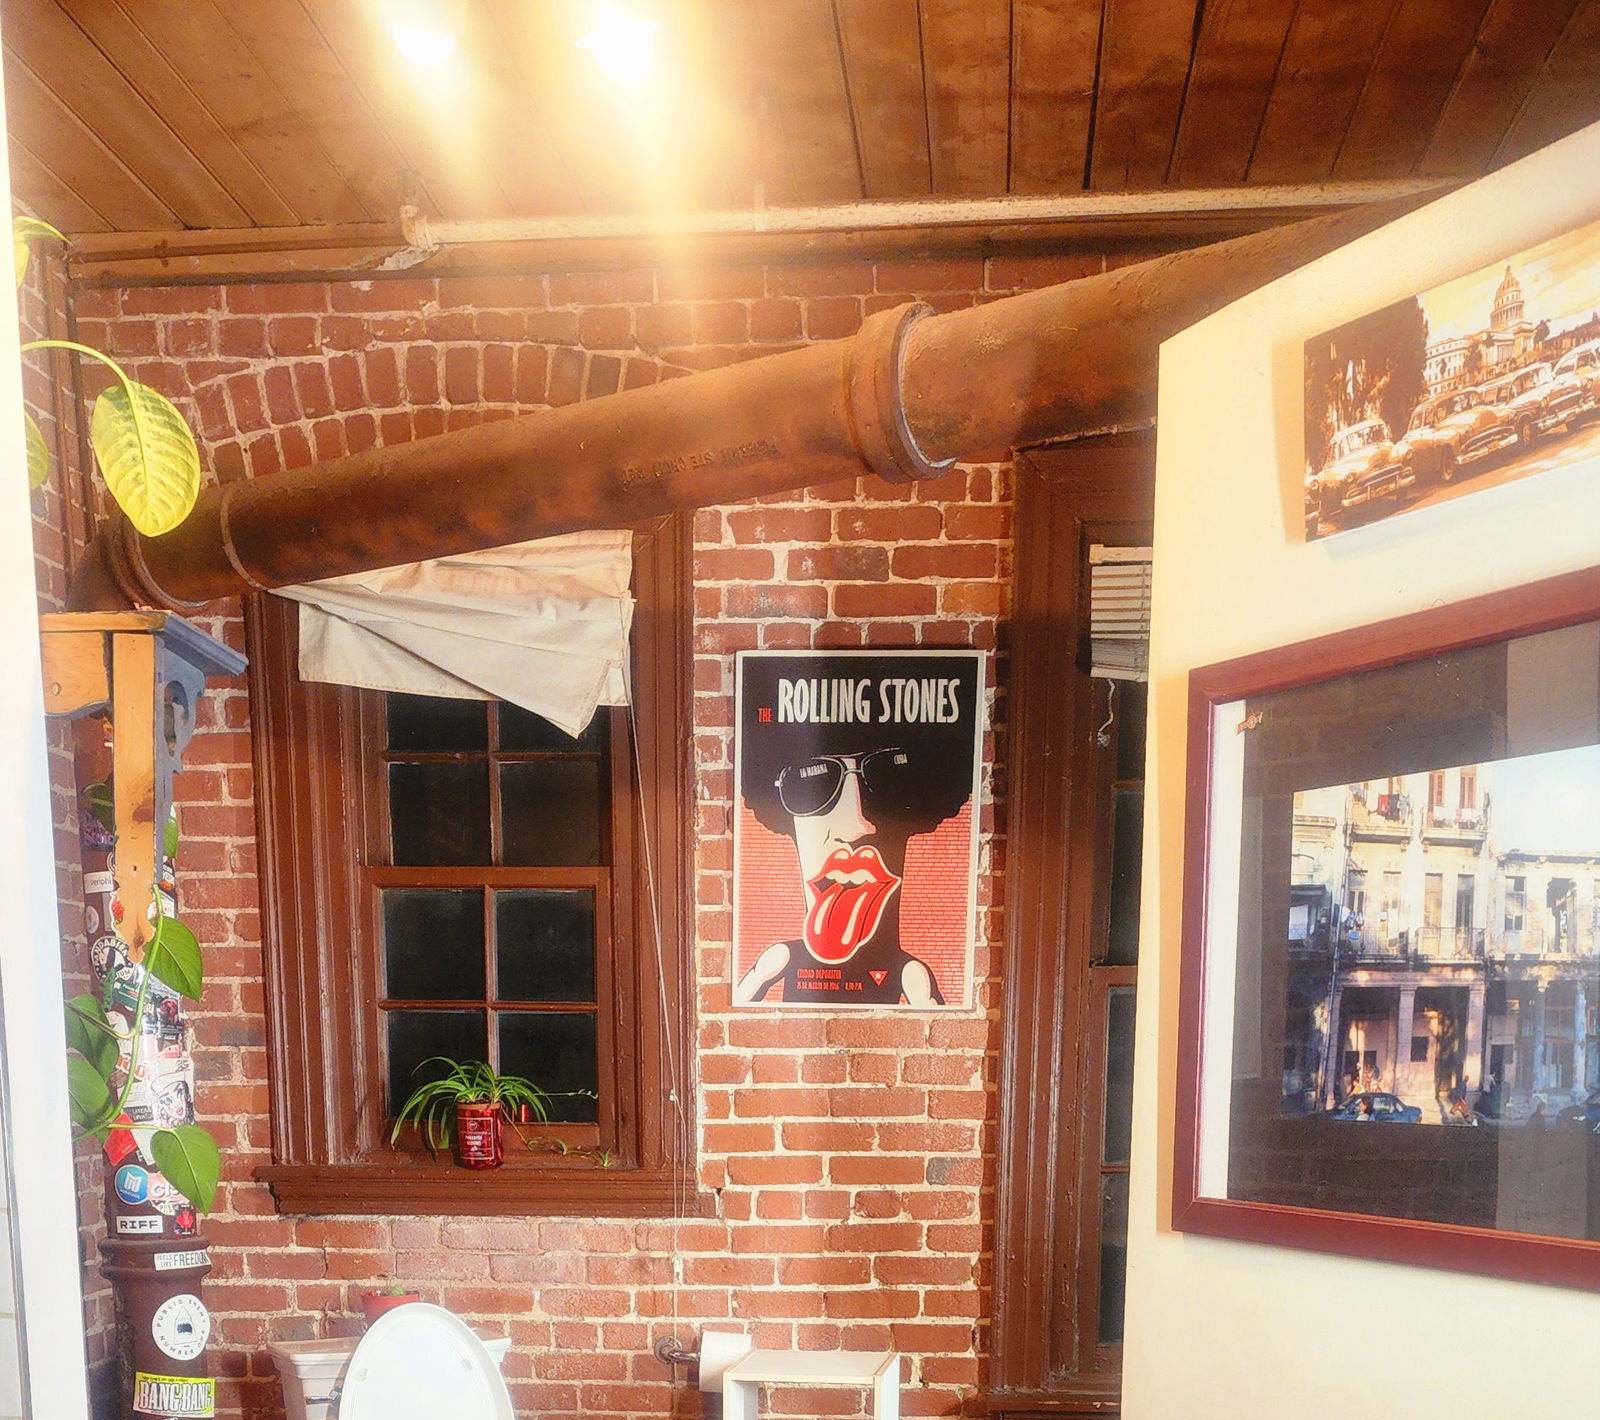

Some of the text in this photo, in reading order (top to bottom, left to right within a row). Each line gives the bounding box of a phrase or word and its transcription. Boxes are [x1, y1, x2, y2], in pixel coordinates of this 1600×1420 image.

[757, 678, 960, 723] THE ROLLING STONES
[120, 1220, 158, 1229] RIFF
[173, 1250, 209, 1267] FREEDOM
[156, 1299, 206, 1328] PUBLIC ENEMY
[160, 1335, 194, 1355] NUMBER
[139, 1381, 212, 1412] BANG BANG
